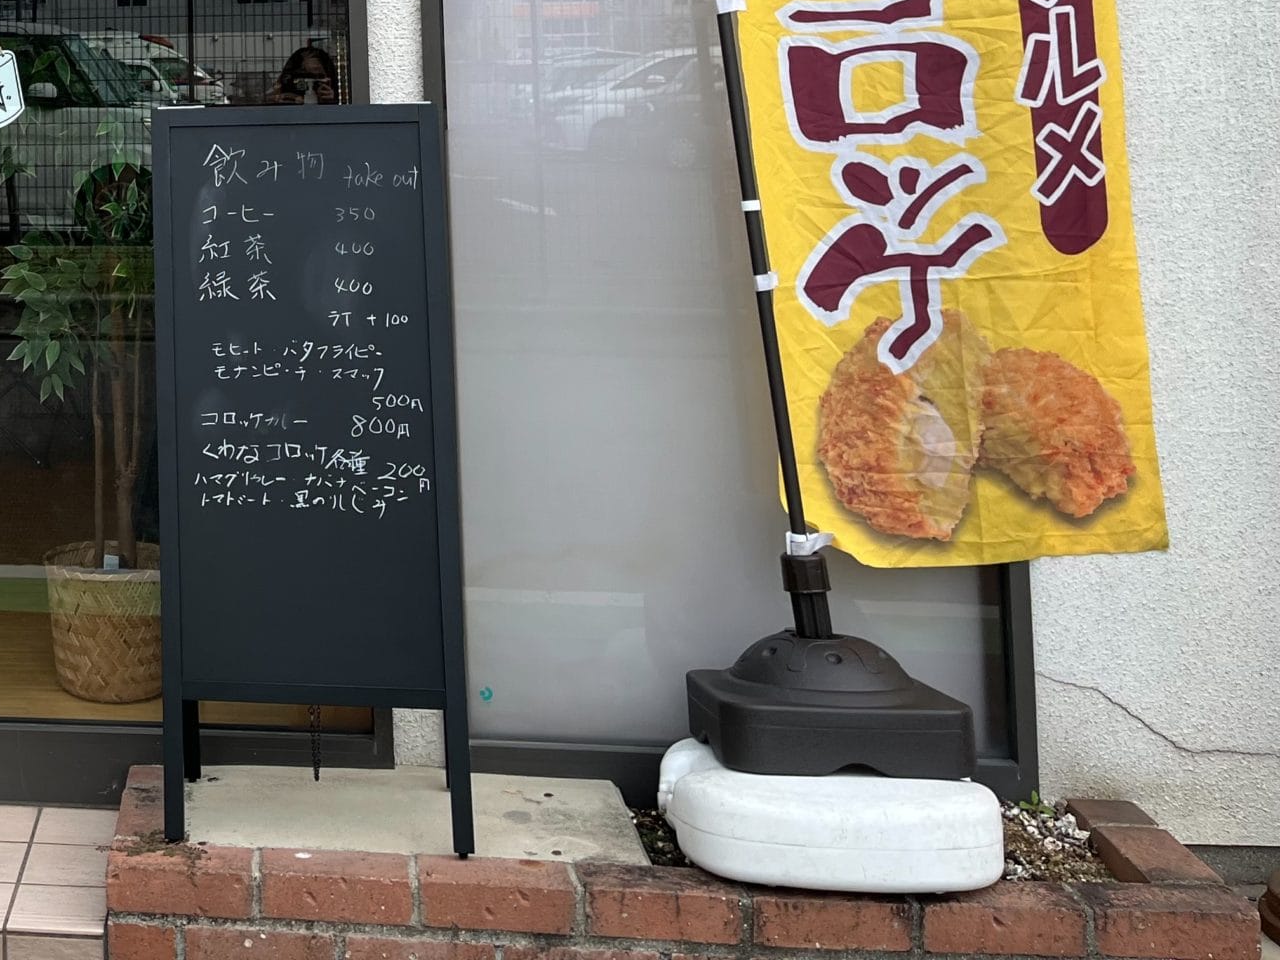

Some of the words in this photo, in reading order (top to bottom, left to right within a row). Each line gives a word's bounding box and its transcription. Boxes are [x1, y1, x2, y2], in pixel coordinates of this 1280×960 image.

[202, 143, 325, 187] 飲み物
[343, 161, 384, 189] take
[393, 165, 419, 189] out
[202, 203, 275, 225] コーヒー
[334, 206, 376, 223] 350
[198, 233, 273, 265] 紅茶
[334, 241, 375, 256] 400
[198, 270, 277, 302] 緑茶
[334, 277, 374, 296] 400
[350, 414, 411, 440] 800円
